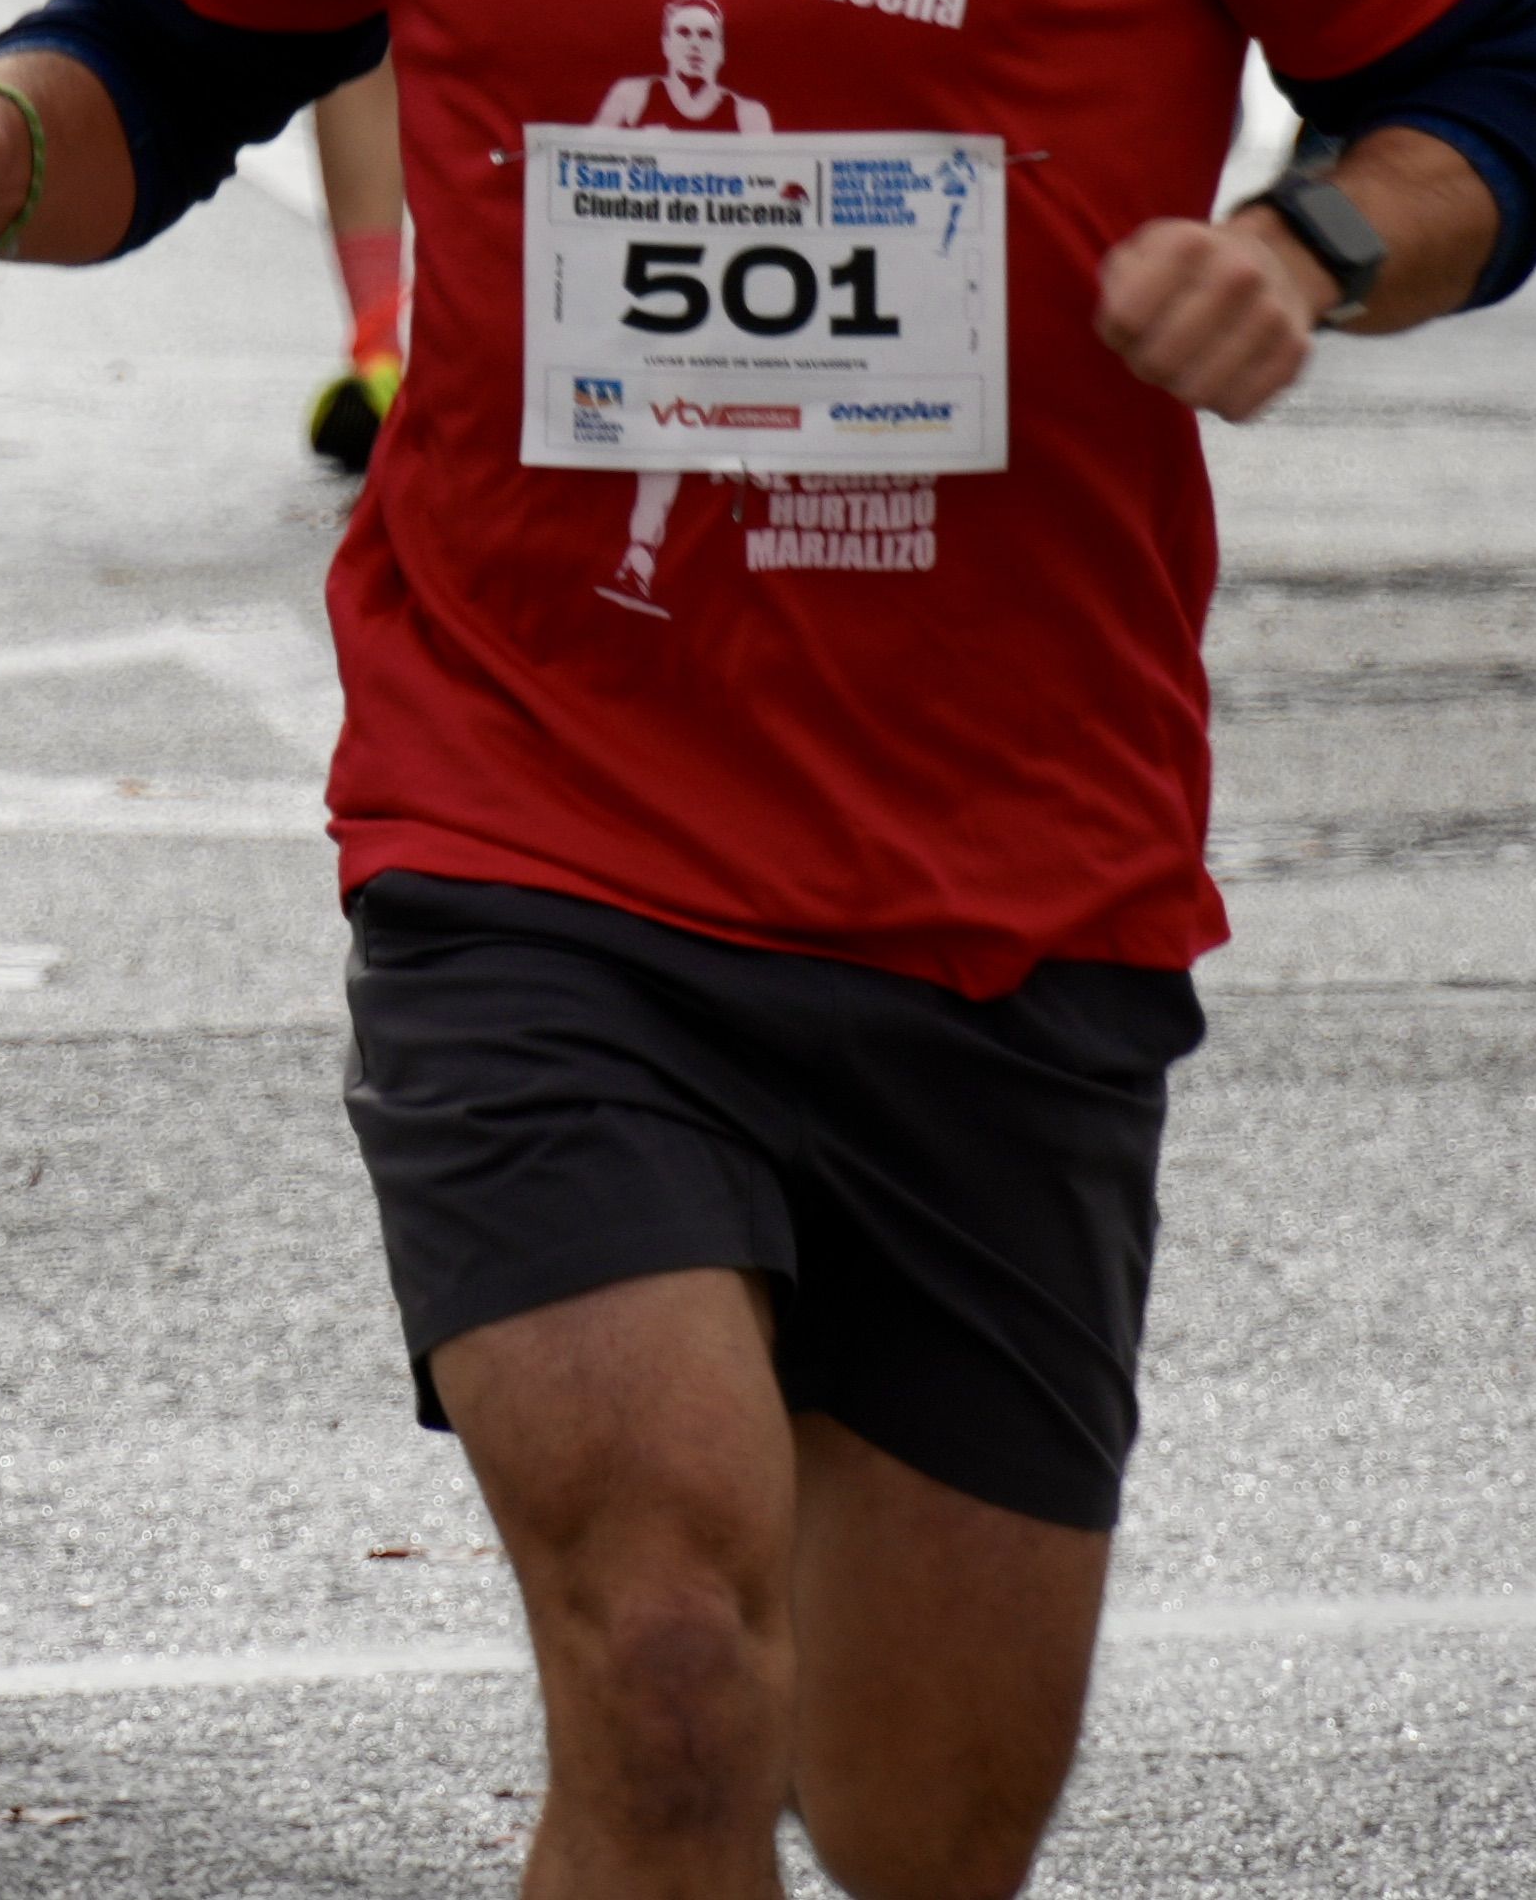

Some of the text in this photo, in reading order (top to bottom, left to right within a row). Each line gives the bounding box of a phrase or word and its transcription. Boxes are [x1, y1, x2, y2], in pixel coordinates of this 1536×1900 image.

[575, 165, 622, 191] San
[627, 166, 744, 197] Silvestre
[573, 191, 804, 226] Ciudad de Lucena
[619, 241, 901, 338] 501
[768, 490, 936, 533] HURTADO
[745, 527, 937, 573] MARJALIZO
